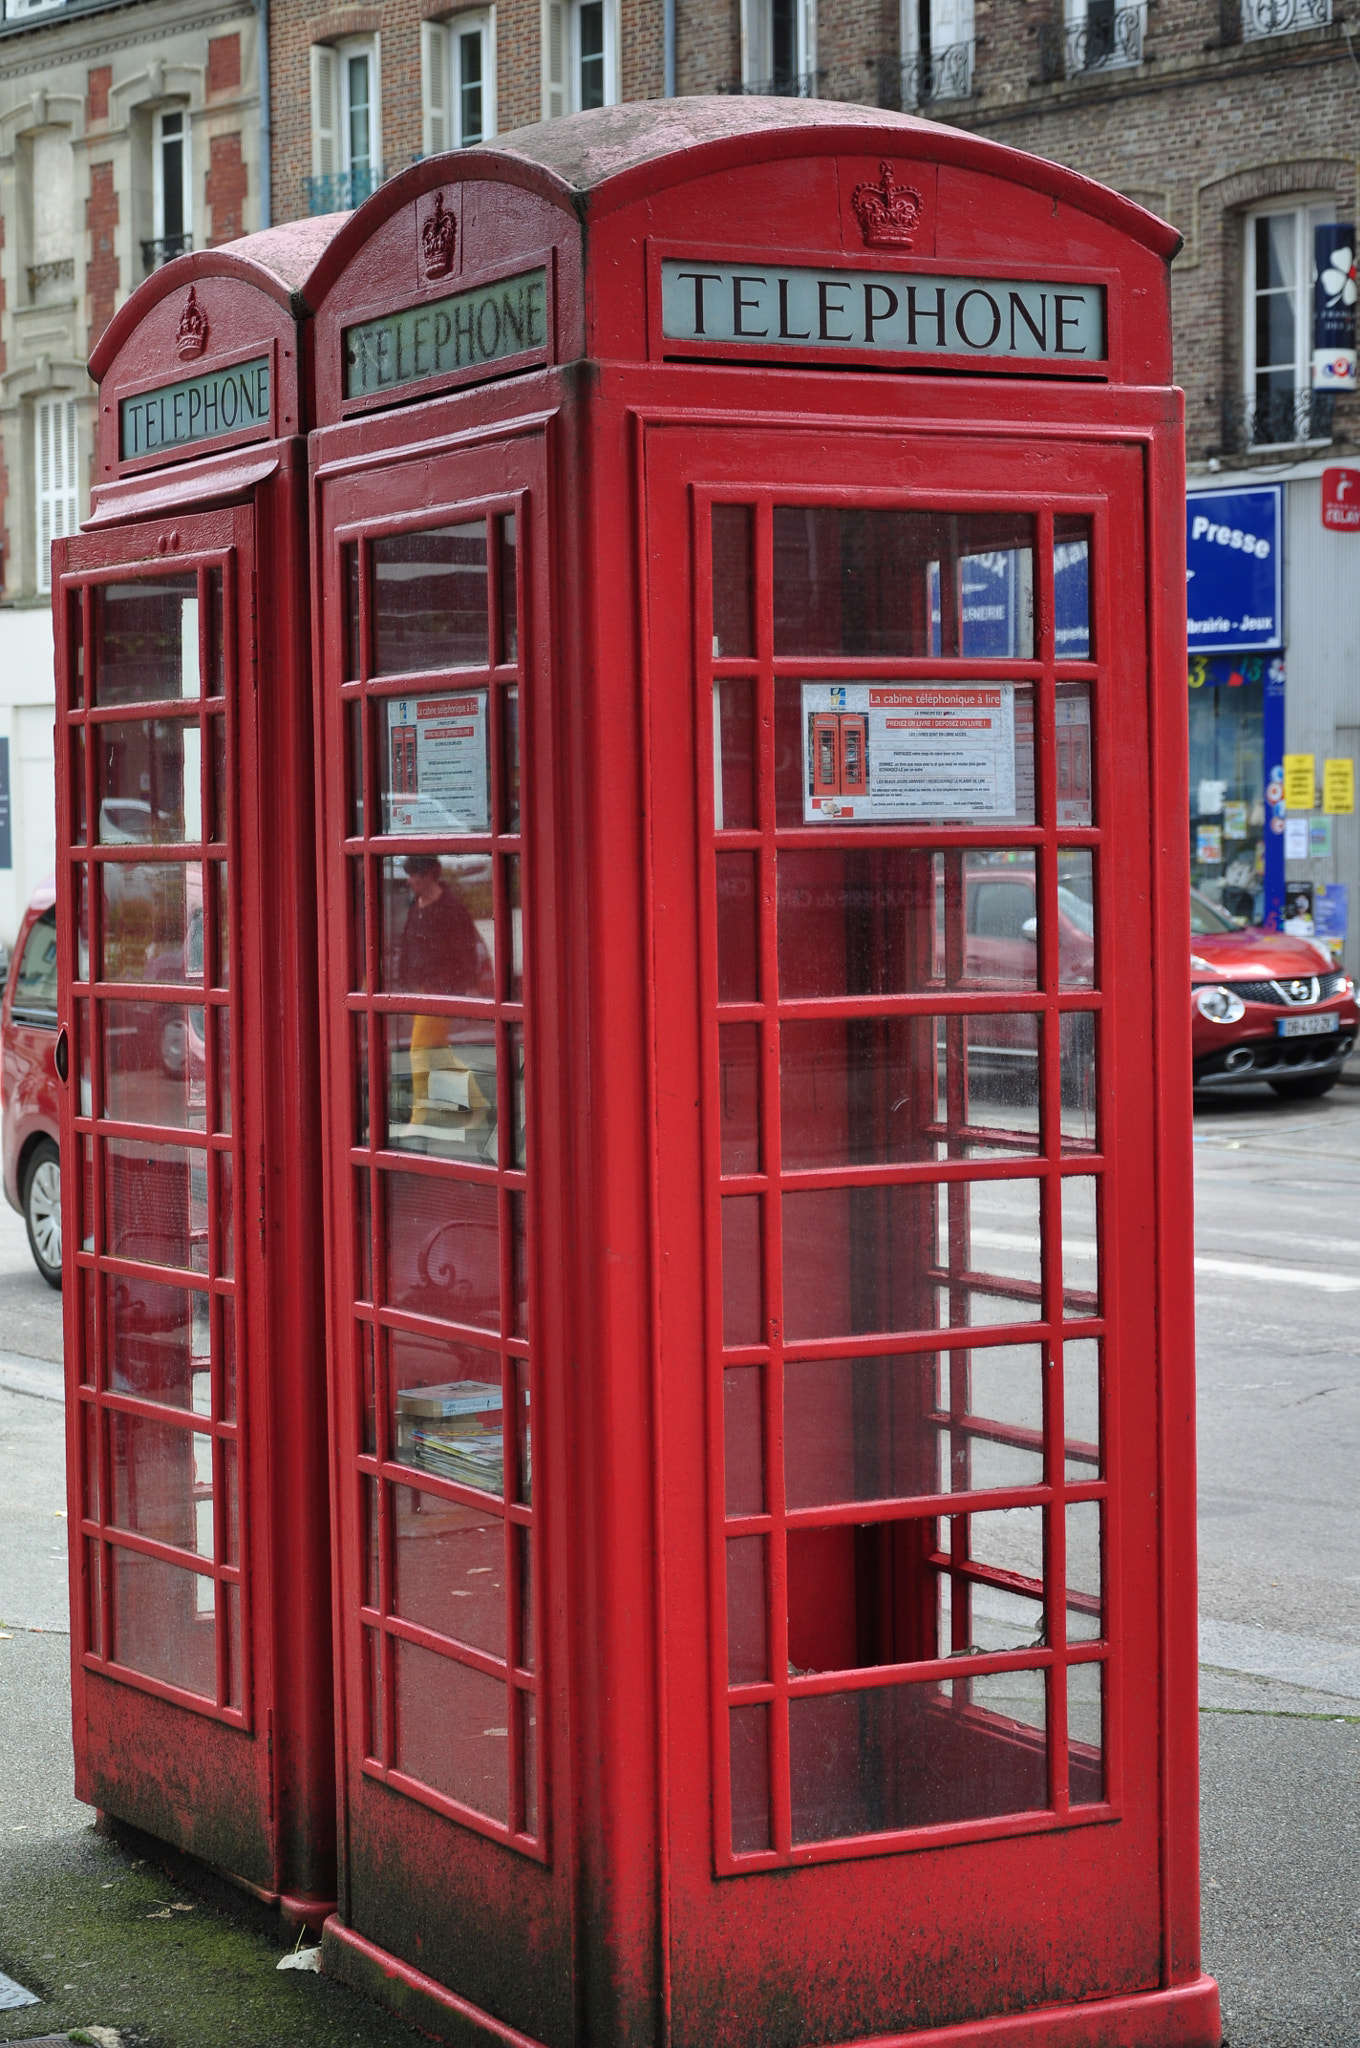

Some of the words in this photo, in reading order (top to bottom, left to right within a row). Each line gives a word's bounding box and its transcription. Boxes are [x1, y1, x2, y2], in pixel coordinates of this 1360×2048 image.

[350, 281, 545, 391] TELEPHONE
[677, 273, 1087, 354] TELEPHONE
[128, 365, 270, 453] TELEPHONE
[1192, 516, 1270, 559] Presse
[1239, 614, 1273, 632] Jeux
[870, 693, 881, 704] La
[883, 693, 913, 704] cabine
[915, 693, 975, 707] téléphonique
[977, 694, 983, 704] à
[985, 693, 1000, 704] lire
